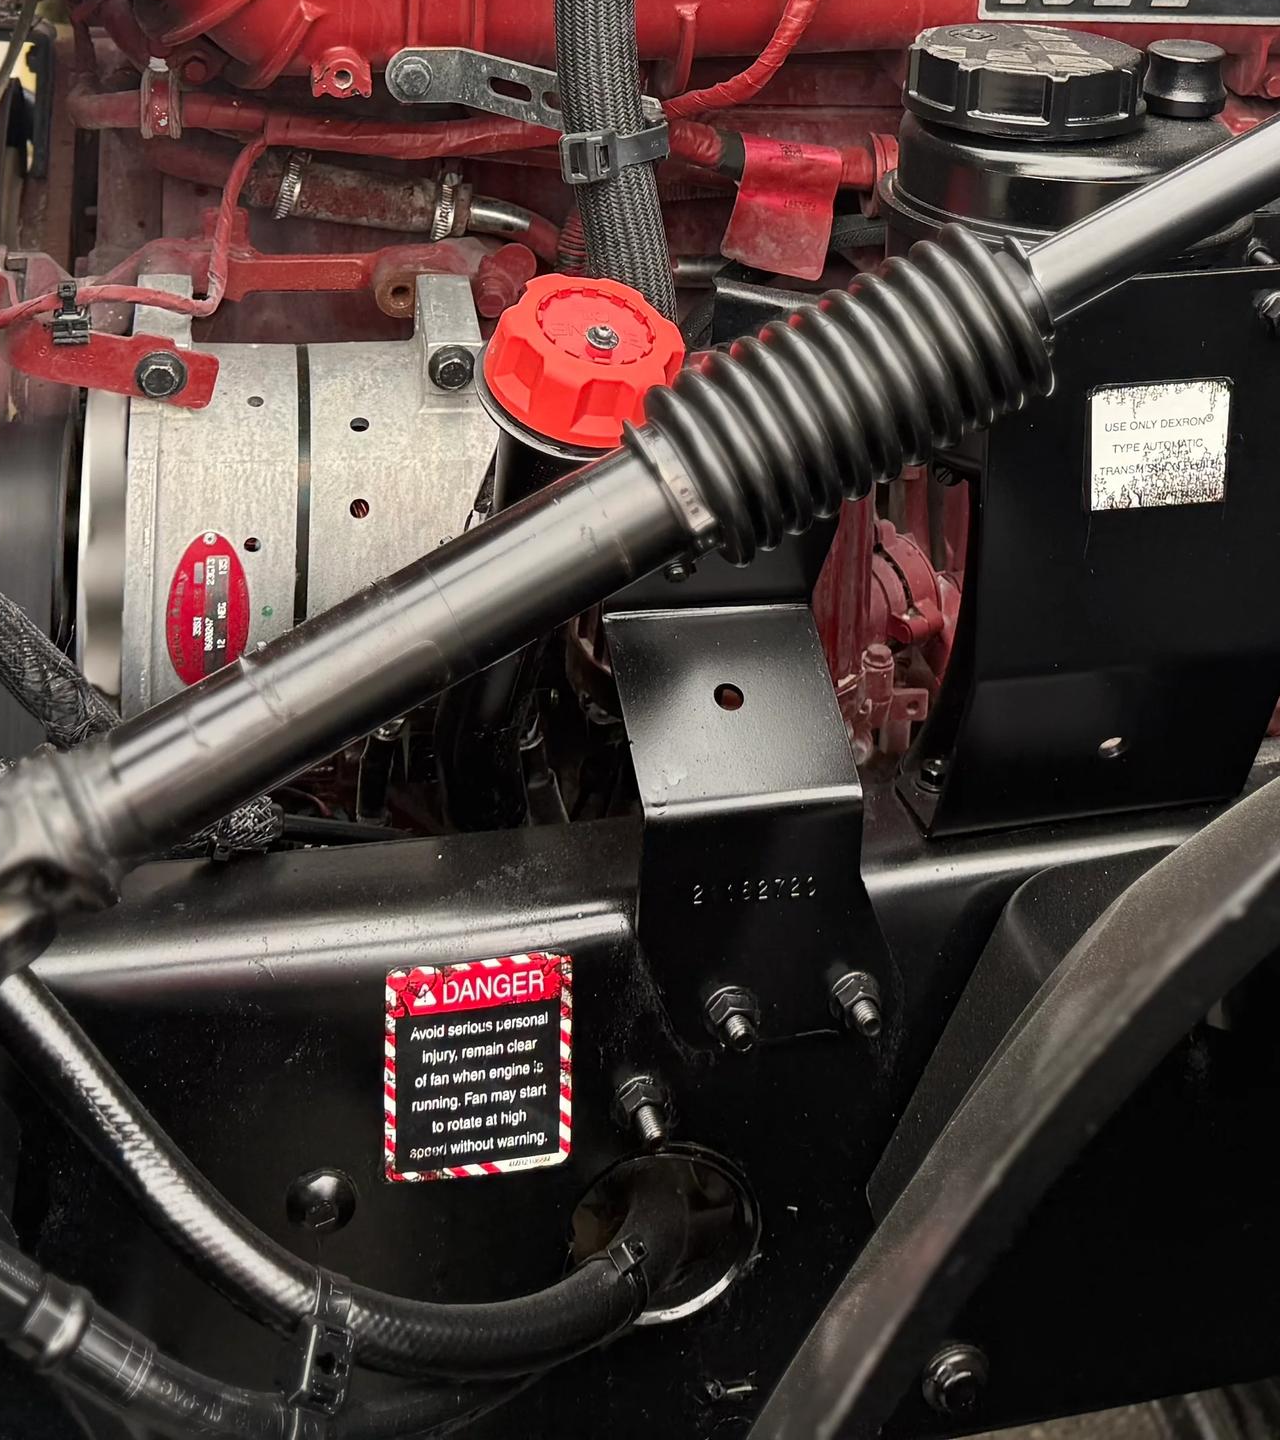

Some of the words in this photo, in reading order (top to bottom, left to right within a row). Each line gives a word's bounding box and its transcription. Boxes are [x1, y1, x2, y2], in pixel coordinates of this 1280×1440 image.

[1104, 421, 1127, 432] USE
[1129, 419, 1158, 431] ONLY
[1112, 442, 1140, 454] TYPE
[1142, 438, 1204, 451] AUTOMATIC
[217, 602, 227, 620] NEG
[216, 638, 226, 649] 12
[442, 969, 545, 1005] DANGER
[410, 1024, 445, 1041] Avoid
[448, 1020, 493, 1037] serious
[496, 1011, 549, 1033] personal
[422, 1049, 458, 1066] injury,
[462, 1041, 504, 1059] remain
[507, 1039, 538, 1053] clear
[414, 1072, 427, 1088] of
[430, 1071, 449, 1085] fan
[453, 1067, 486, 1084] when
[489, 1062, 530, 1080] engine
[411, 1095, 461, 1113] running.
[464, 1091, 488, 1107] Fan
[491, 1088, 517, 1104] may
[519, 1083, 547, 1099] start
[432, 1120, 444, 1134] to
[447, 1114, 482, 1132] rotate
[485, 1113, 497, 1127] at
[500, 1108, 527, 1127] high
[450, 1136, 494, 1154] without
[497, 1130, 548, 1150] warning.
